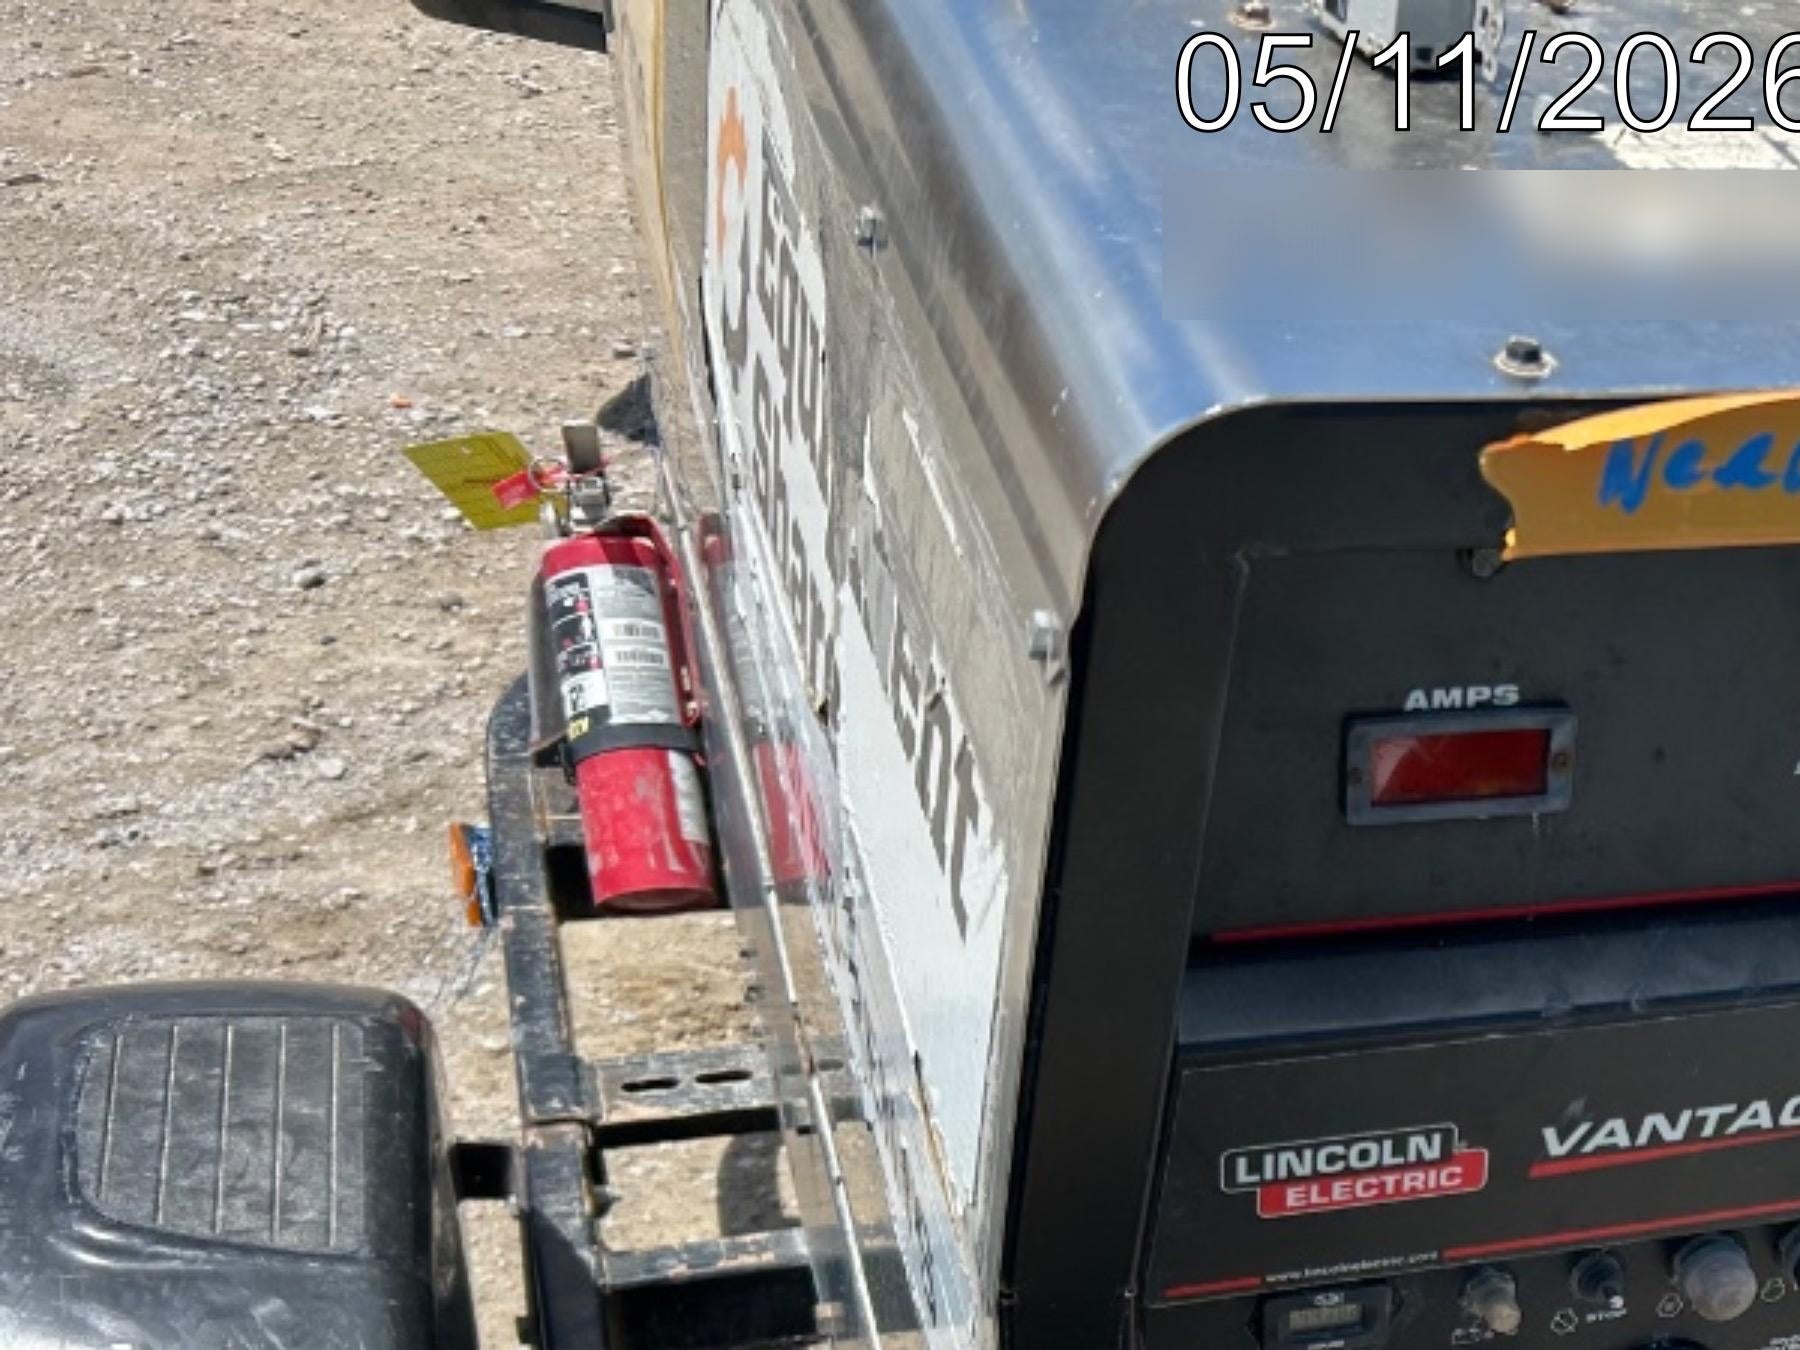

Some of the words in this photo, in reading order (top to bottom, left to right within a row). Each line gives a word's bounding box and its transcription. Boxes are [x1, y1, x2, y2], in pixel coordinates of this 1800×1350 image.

[1403, 684, 1520, 712] AMPS
[1235, 1133, 1442, 1183] LINCOLN
[1285, 1165, 1464, 1209] ELECTRIC
